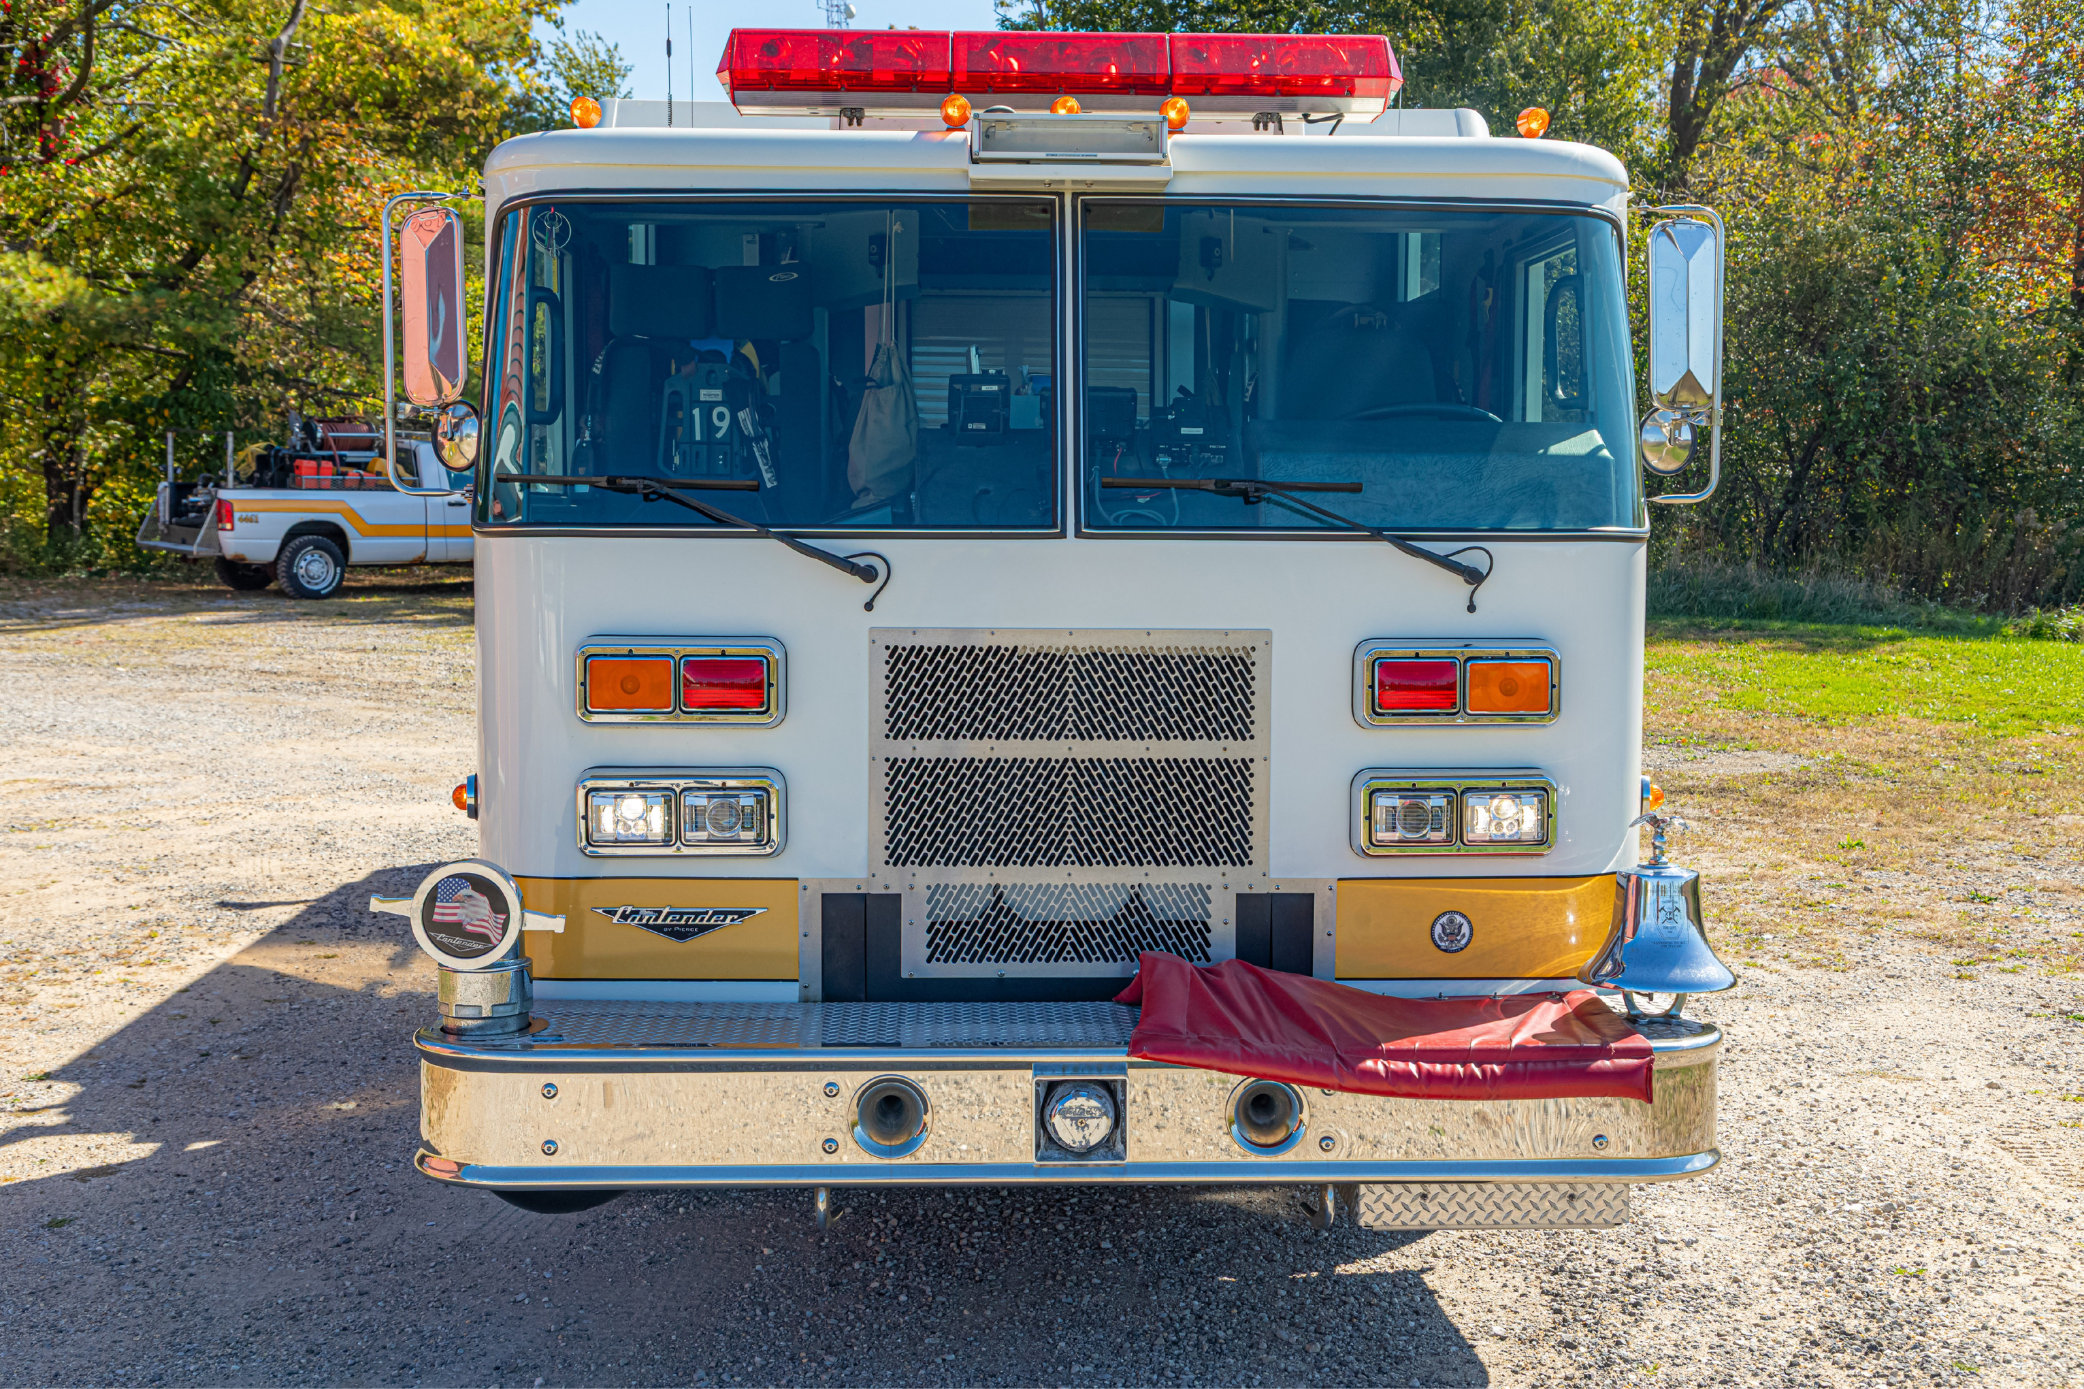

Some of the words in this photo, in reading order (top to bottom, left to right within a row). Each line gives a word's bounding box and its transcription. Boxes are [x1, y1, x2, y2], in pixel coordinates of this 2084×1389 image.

[692, 405, 731, 442] 19
[612, 904, 744, 925] Contender
[436, 933, 485, 950] Contender
